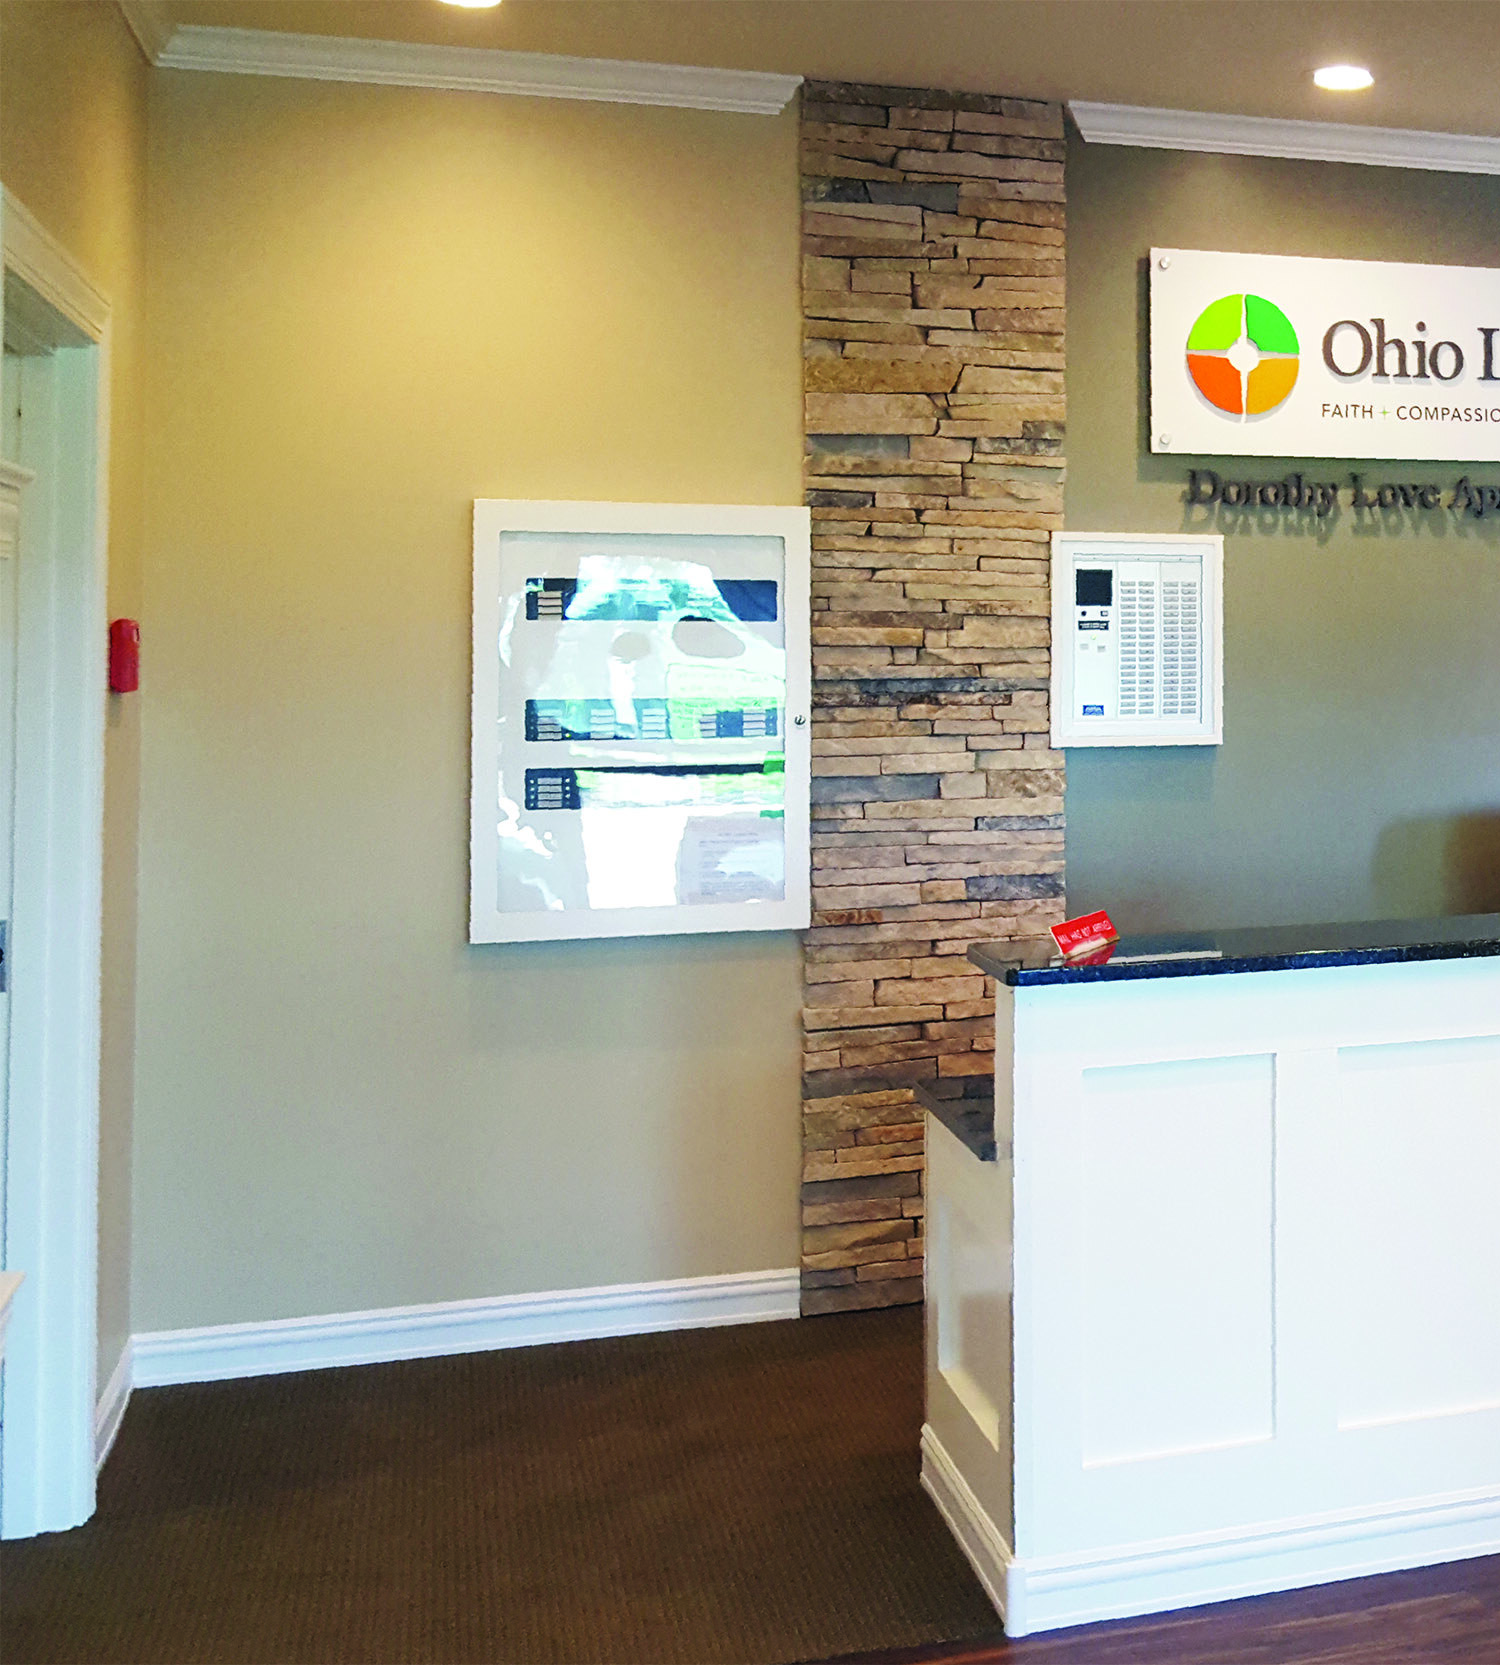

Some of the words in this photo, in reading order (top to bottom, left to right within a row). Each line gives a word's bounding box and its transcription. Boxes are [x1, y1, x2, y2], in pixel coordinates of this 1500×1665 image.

[1321, 318, 1465, 381] Ohio
[1321, 403, 1374, 419] FAITH
[1185, 468, 1339, 518] Dorothy
[1348, 472, 1443, 511] Love
